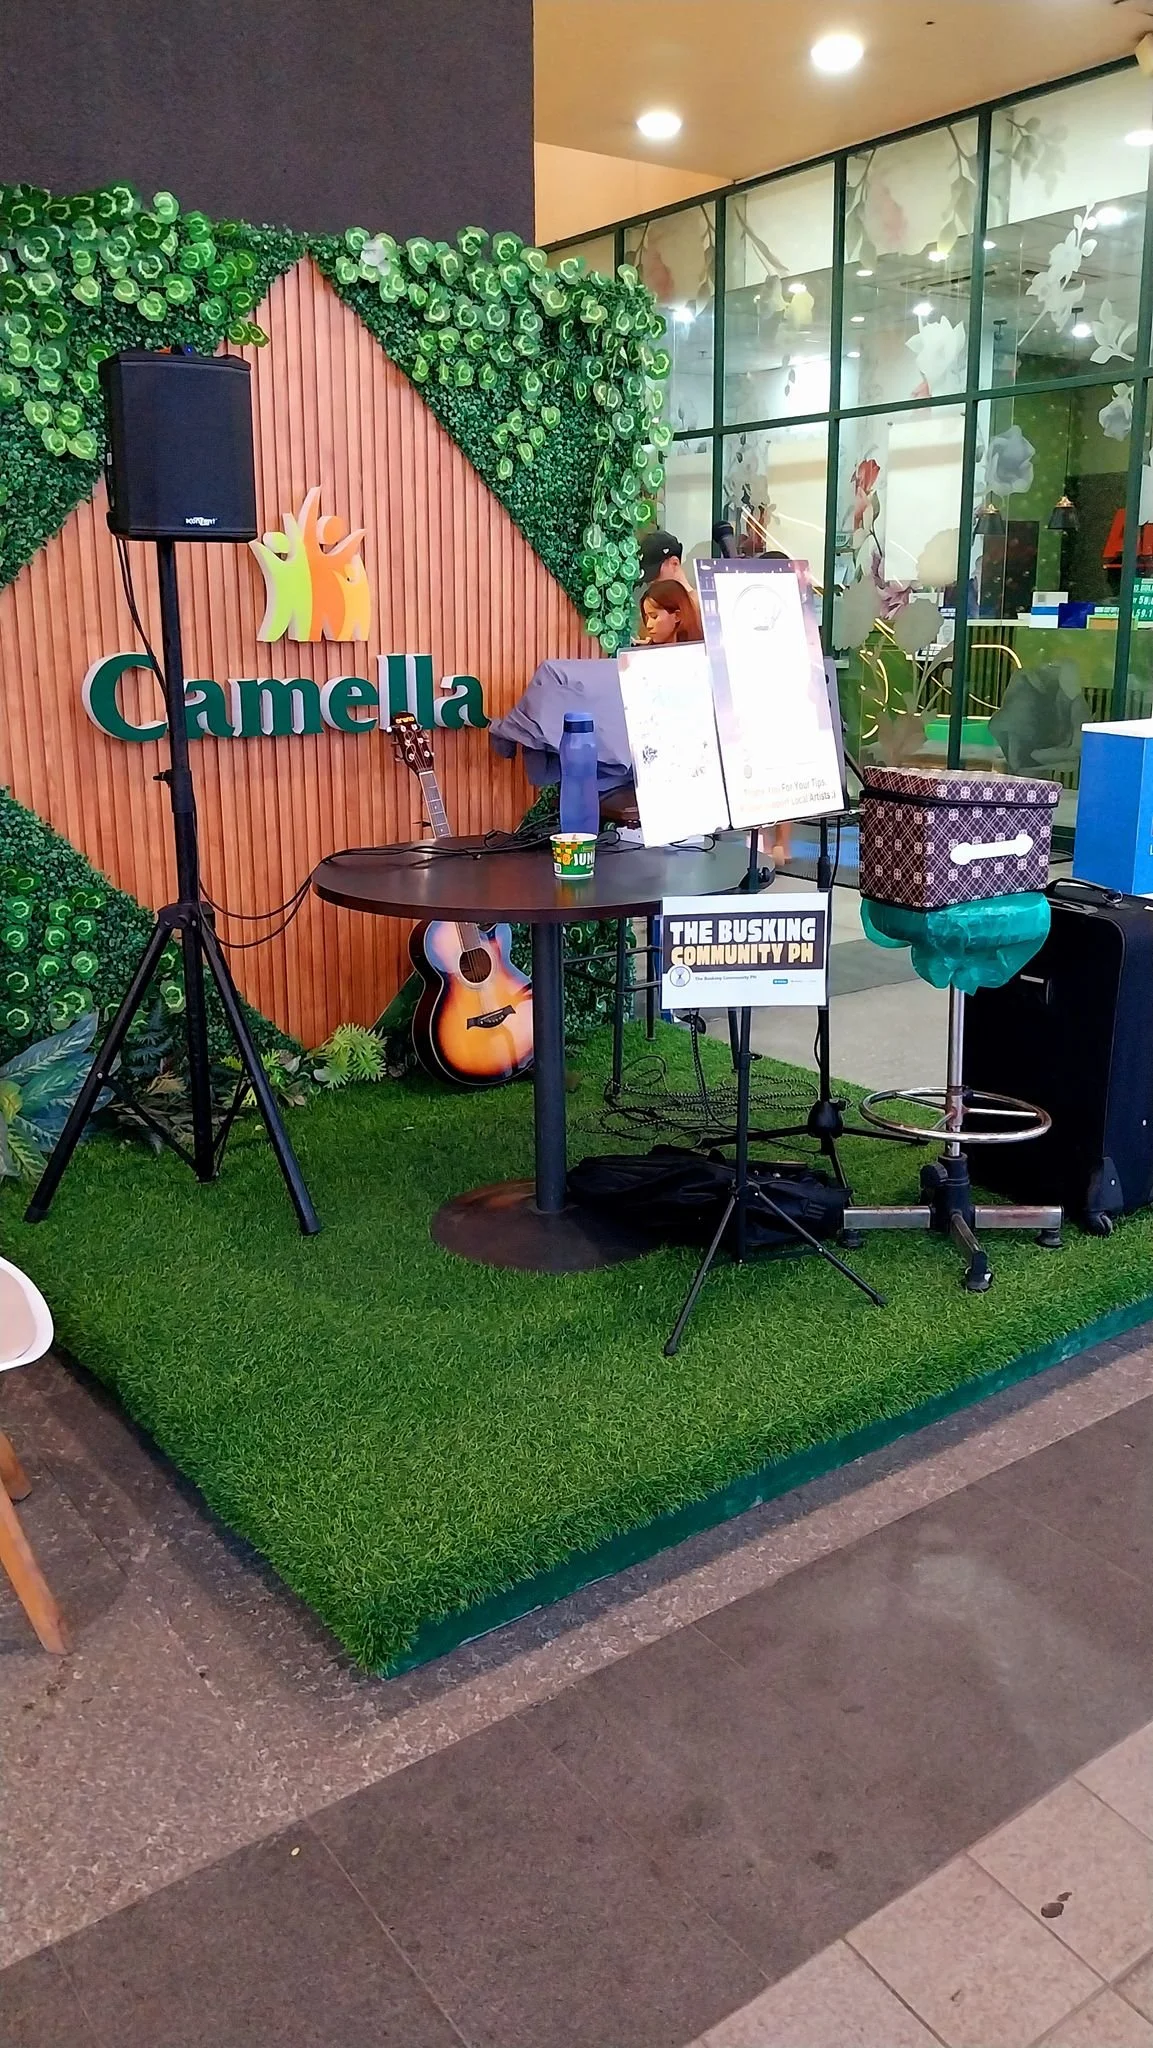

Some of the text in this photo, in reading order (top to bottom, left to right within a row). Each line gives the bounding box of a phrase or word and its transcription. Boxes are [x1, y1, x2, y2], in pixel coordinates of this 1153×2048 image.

[82, 652, 490, 743] Camella
[669, 917, 816, 945] THE BUSKING
[671, 942, 814, 966] COMMUNITY PH
